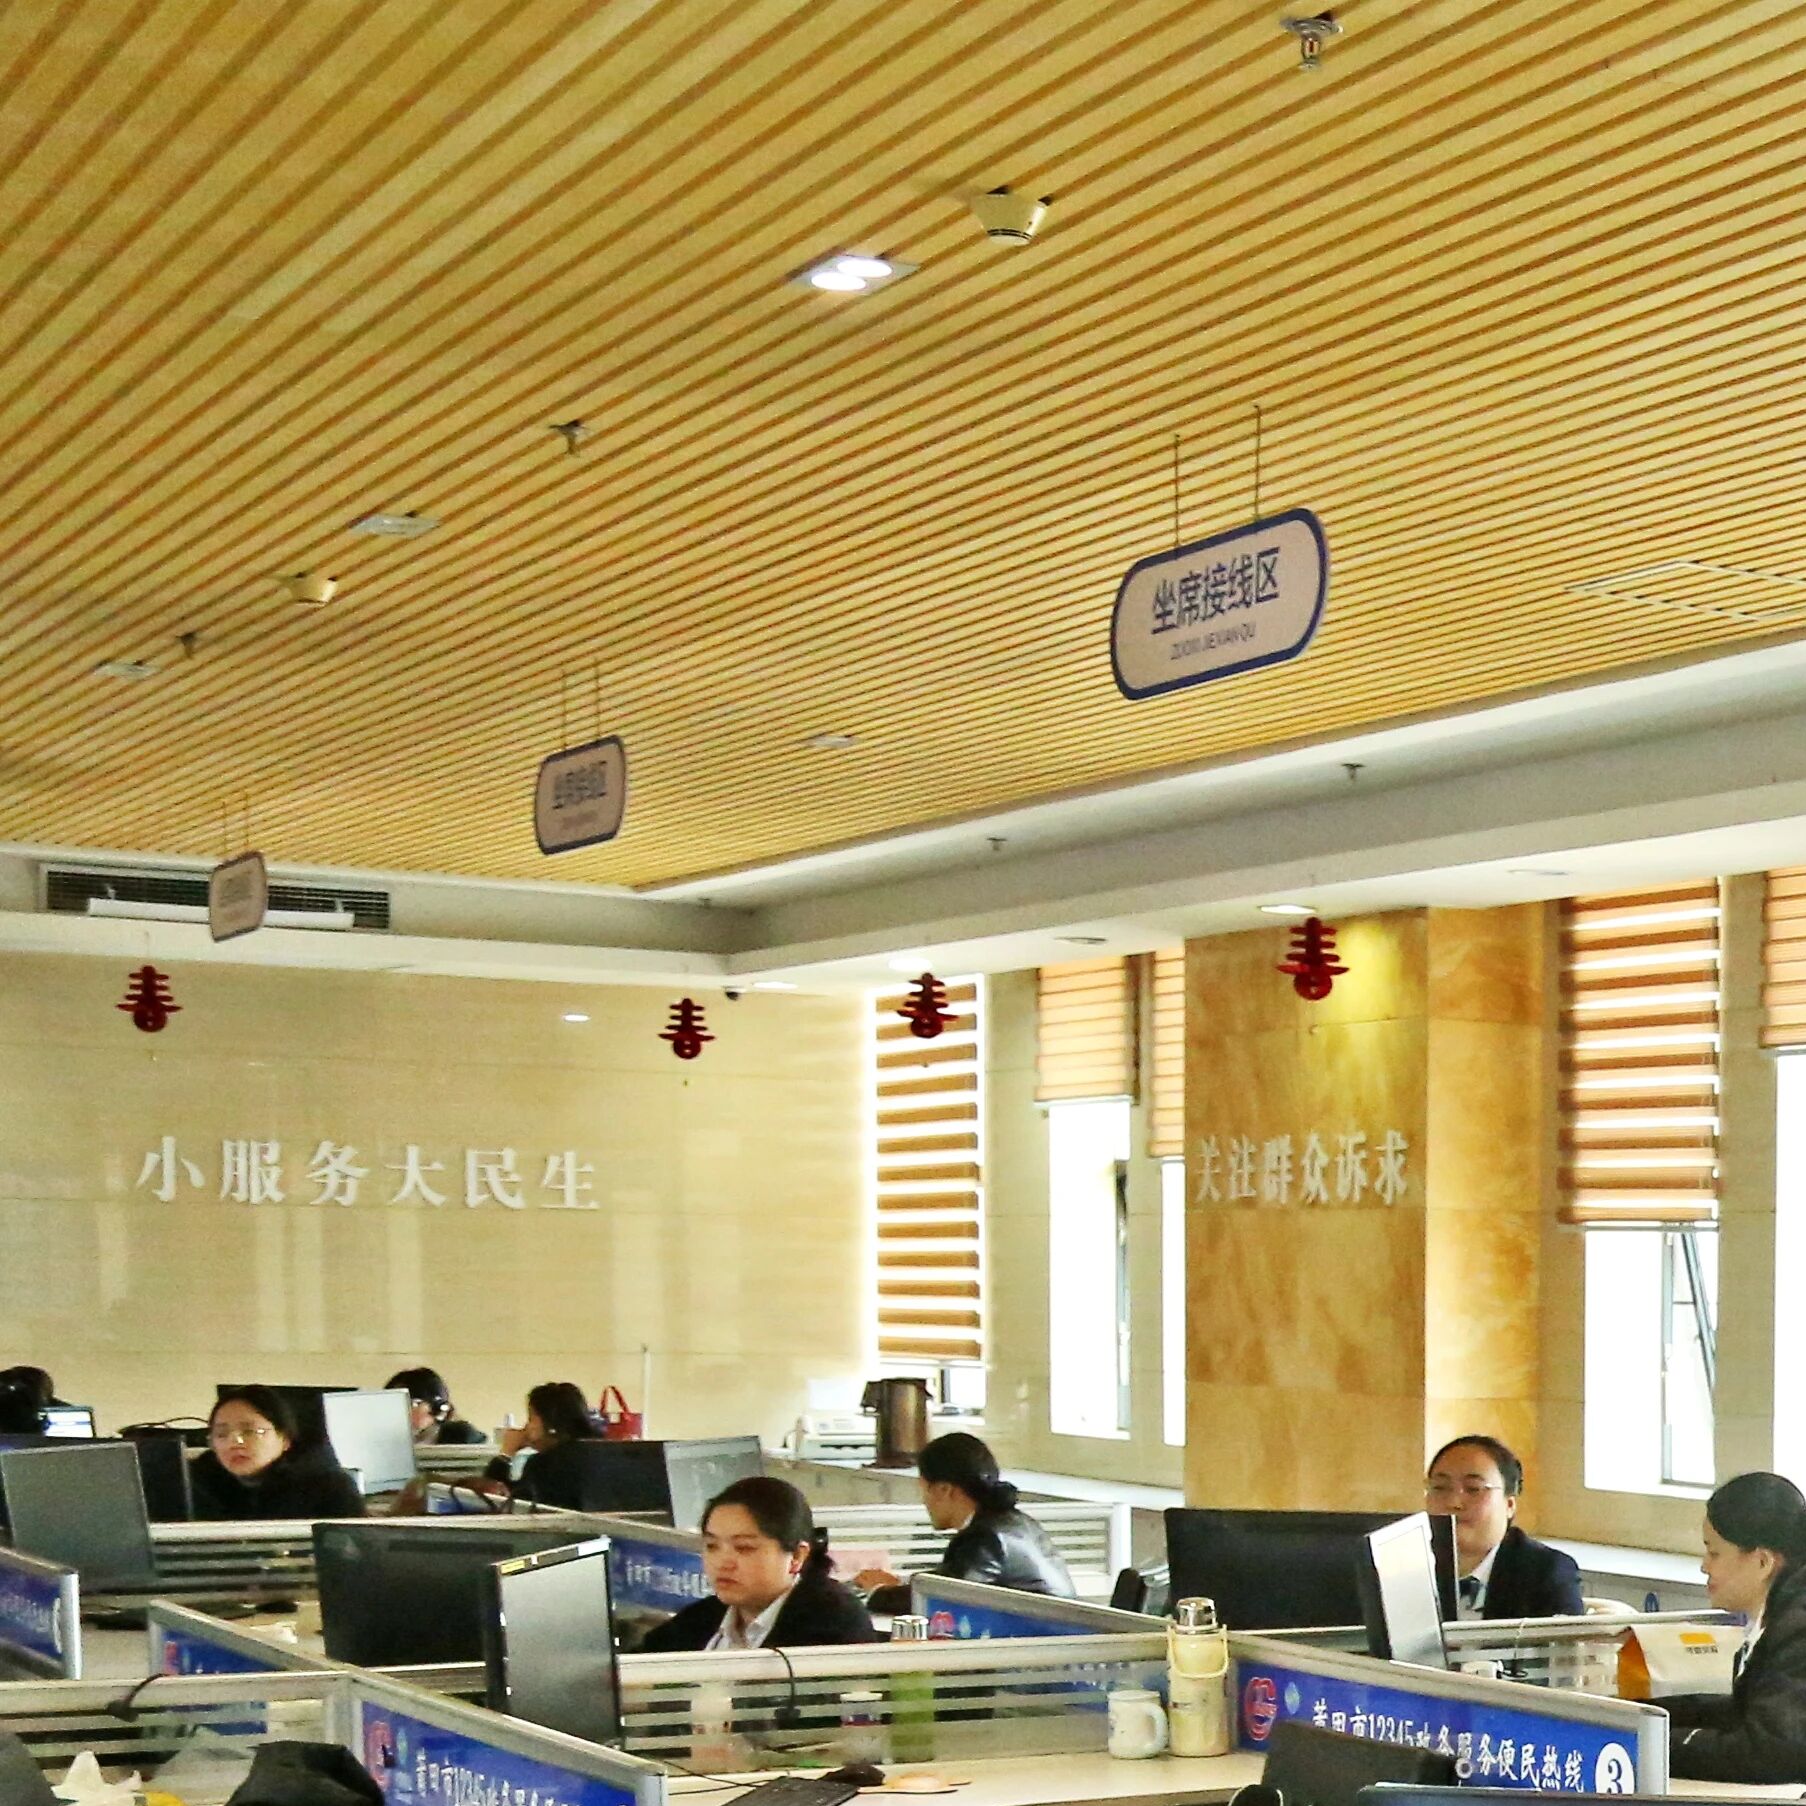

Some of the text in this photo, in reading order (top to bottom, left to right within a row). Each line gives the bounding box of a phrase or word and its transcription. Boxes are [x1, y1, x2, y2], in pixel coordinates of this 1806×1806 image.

[1152, 547, 1280, 635] 坐席接线区
[135, 1136, 600, 1211] 小服务大民生
[1196, 1130, 1408, 1205] 关注群众诉求
